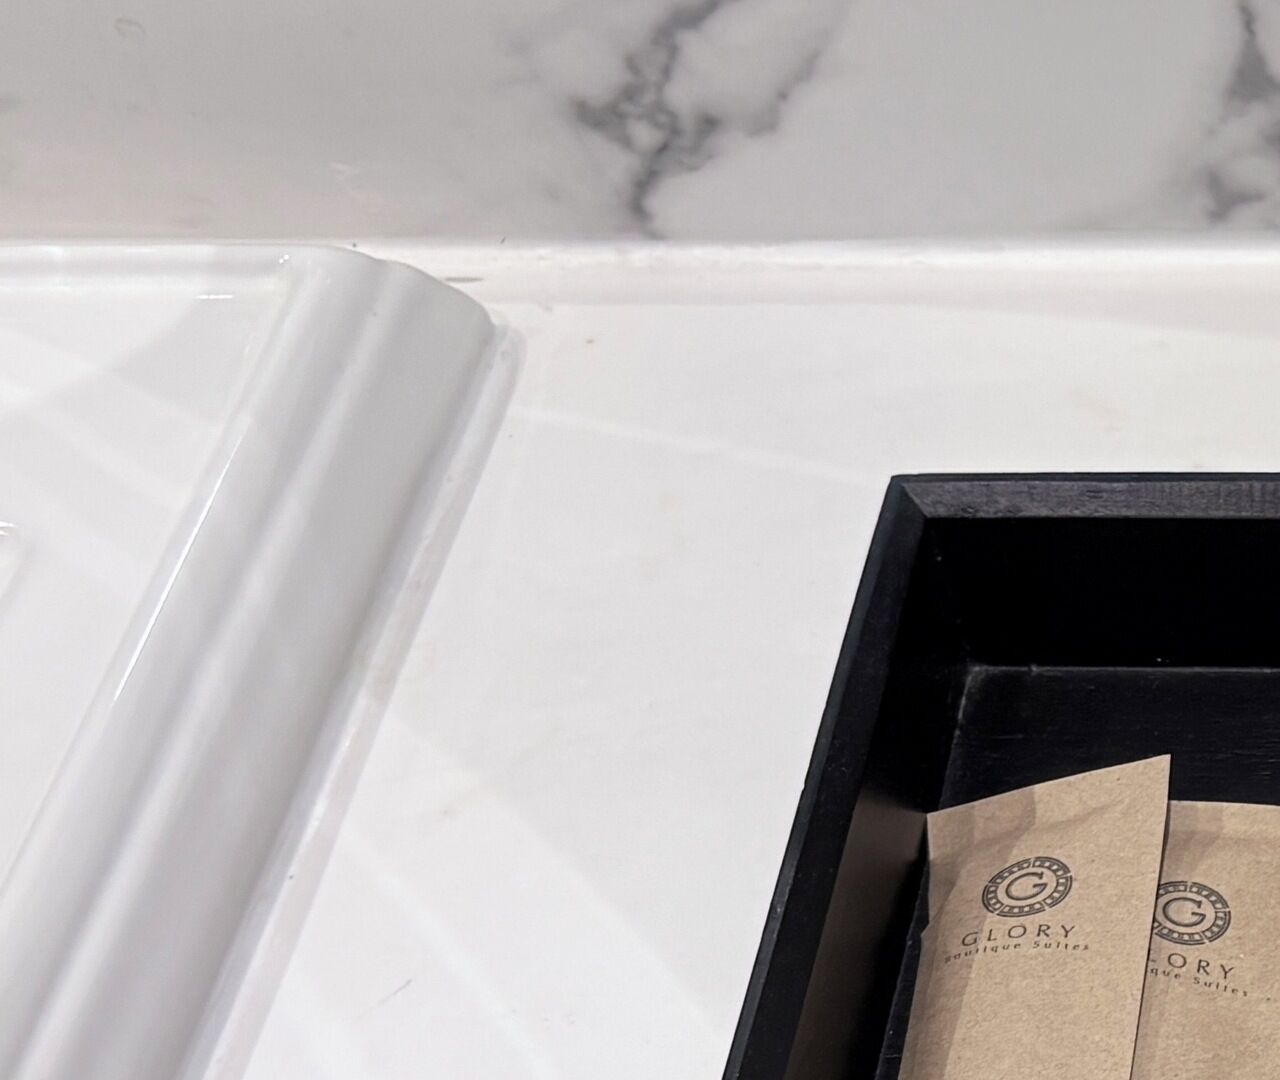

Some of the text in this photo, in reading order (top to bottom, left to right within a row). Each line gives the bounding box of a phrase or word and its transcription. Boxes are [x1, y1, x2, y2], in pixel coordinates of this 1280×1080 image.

[961, 923, 1077, 947] GLORY
[1148, 953, 1236, 981] ORY
[1193, 977, 1249, 998] Suites
